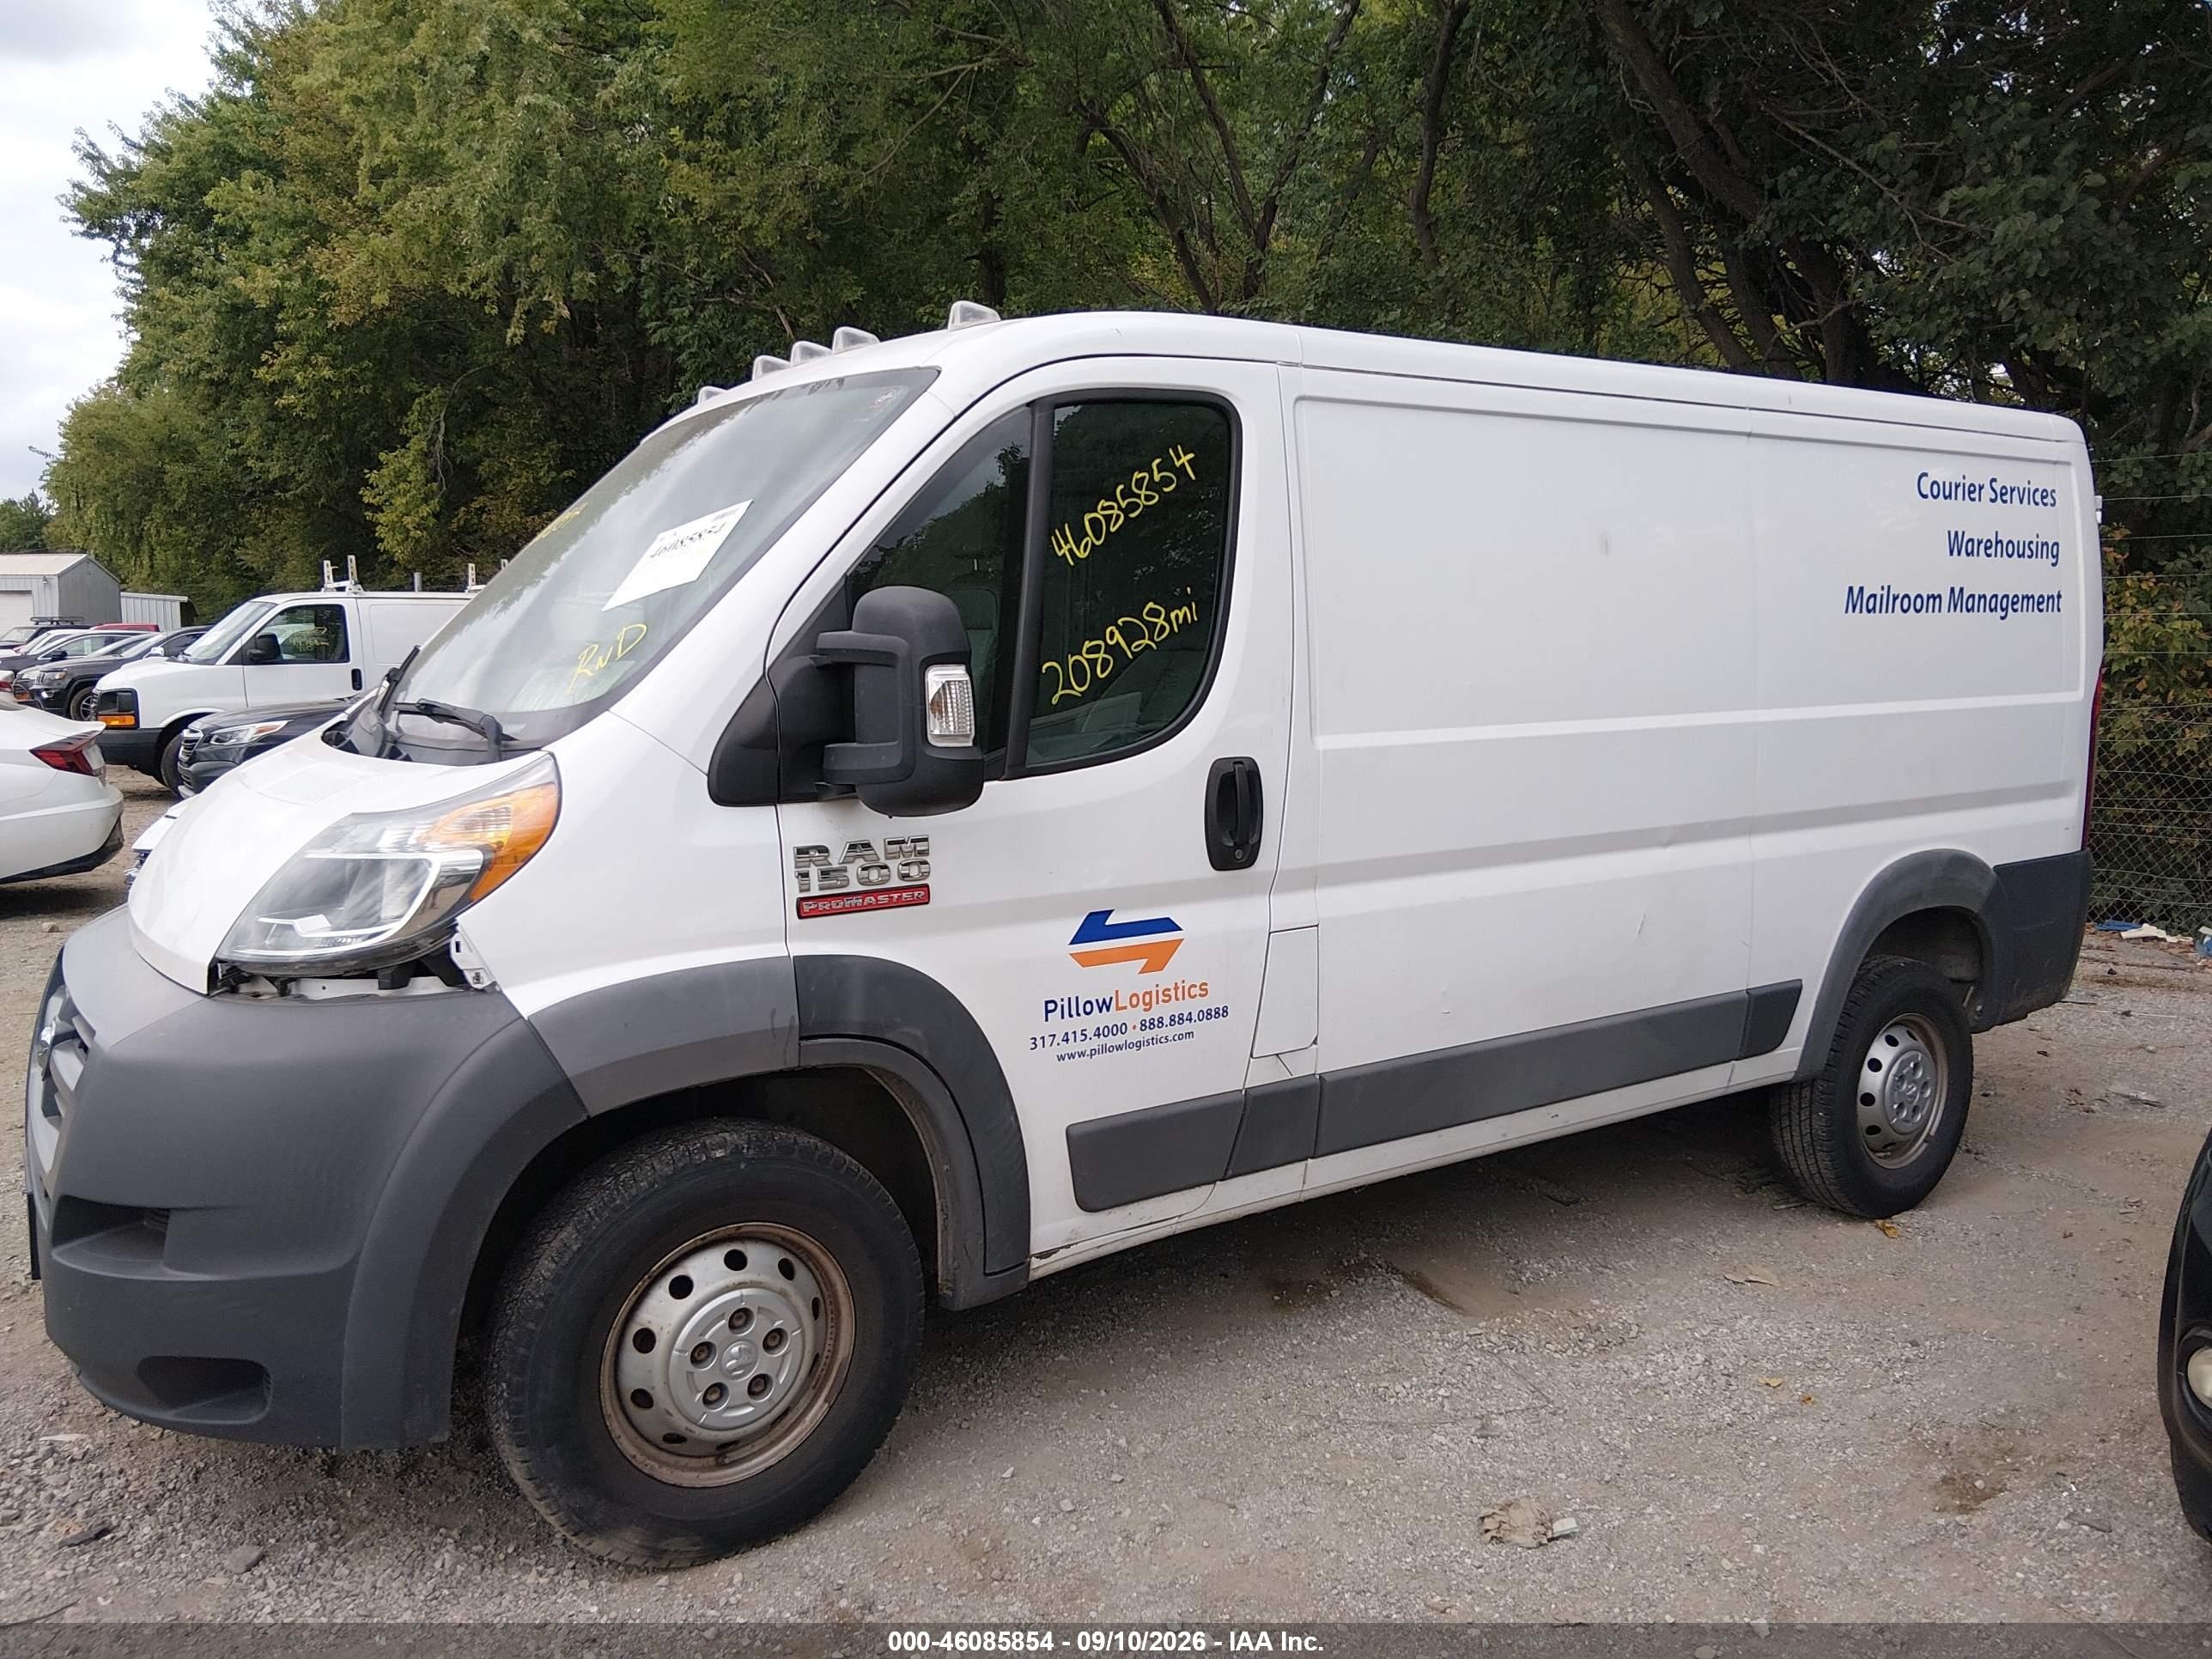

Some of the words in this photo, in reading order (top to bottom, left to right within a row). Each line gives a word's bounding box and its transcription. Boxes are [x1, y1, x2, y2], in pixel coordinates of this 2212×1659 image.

[1051, 445, 1196, 566] 46085854
[1917, 472, 1984, 502] Courier
[1989, 477, 2057, 507] Services
[1948, 530, 2060, 568] Warehousing
[1844, 585, 1942, 614] Mailroom
[1948, 586, 2063, 621] Management
[793, 835, 930, 869] RAM
[795, 859, 931, 893] 1500
[1044, 980, 1209, 1022] PillowLogistics
[1030, 1022, 1128, 1050] 317.415.4000
[1139, 1005, 1229, 1032] 888.884.0888
[1056, 1031, 1194, 1062] www.pillowlogistics.com
